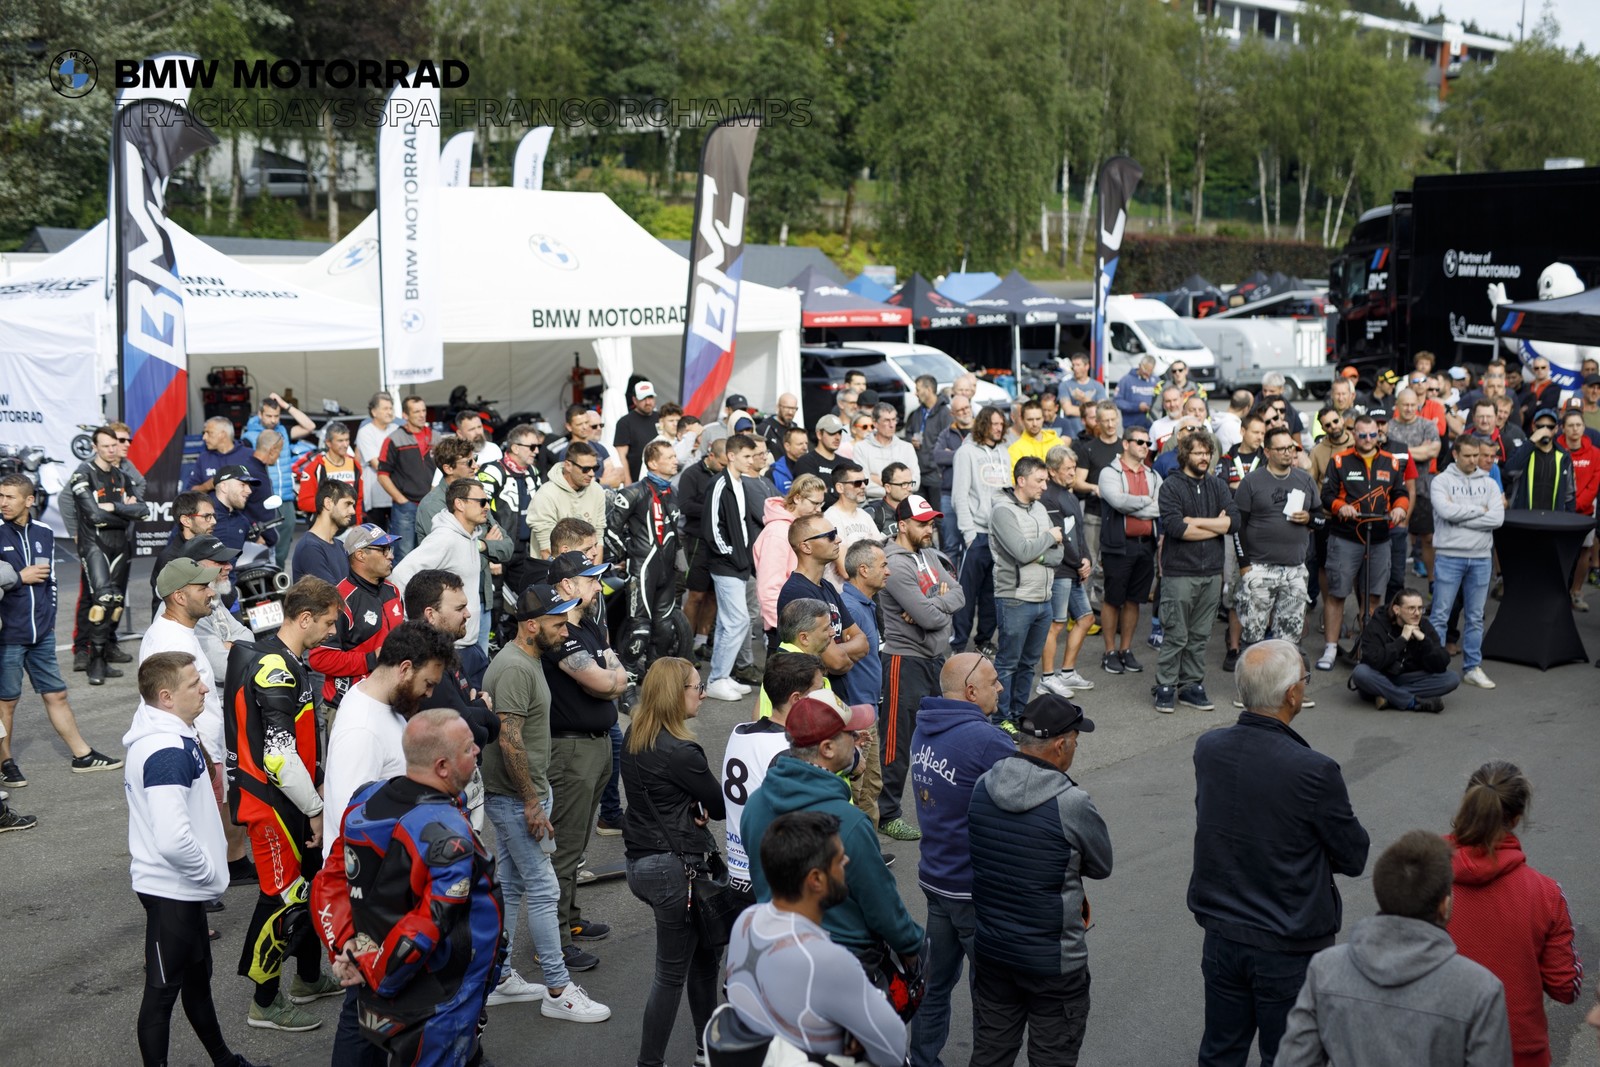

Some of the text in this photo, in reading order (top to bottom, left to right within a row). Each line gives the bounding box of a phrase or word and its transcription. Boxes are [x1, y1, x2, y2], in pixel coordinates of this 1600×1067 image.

[404, 122, 419, 300] BMW MOTORRAD
[1458, 265, 1521, 278] BMW MOTORRAD
[185, 287, 299, 299] MOTORRAD
[532, 306, 687, 328] BMW MOTORRAD
[1466, 324, 1496, 337] MICHE
[1452, 485, 1487, 496] POLO
[724, 757, 749, 806] 8
[729, 875, 753, 893] 57
